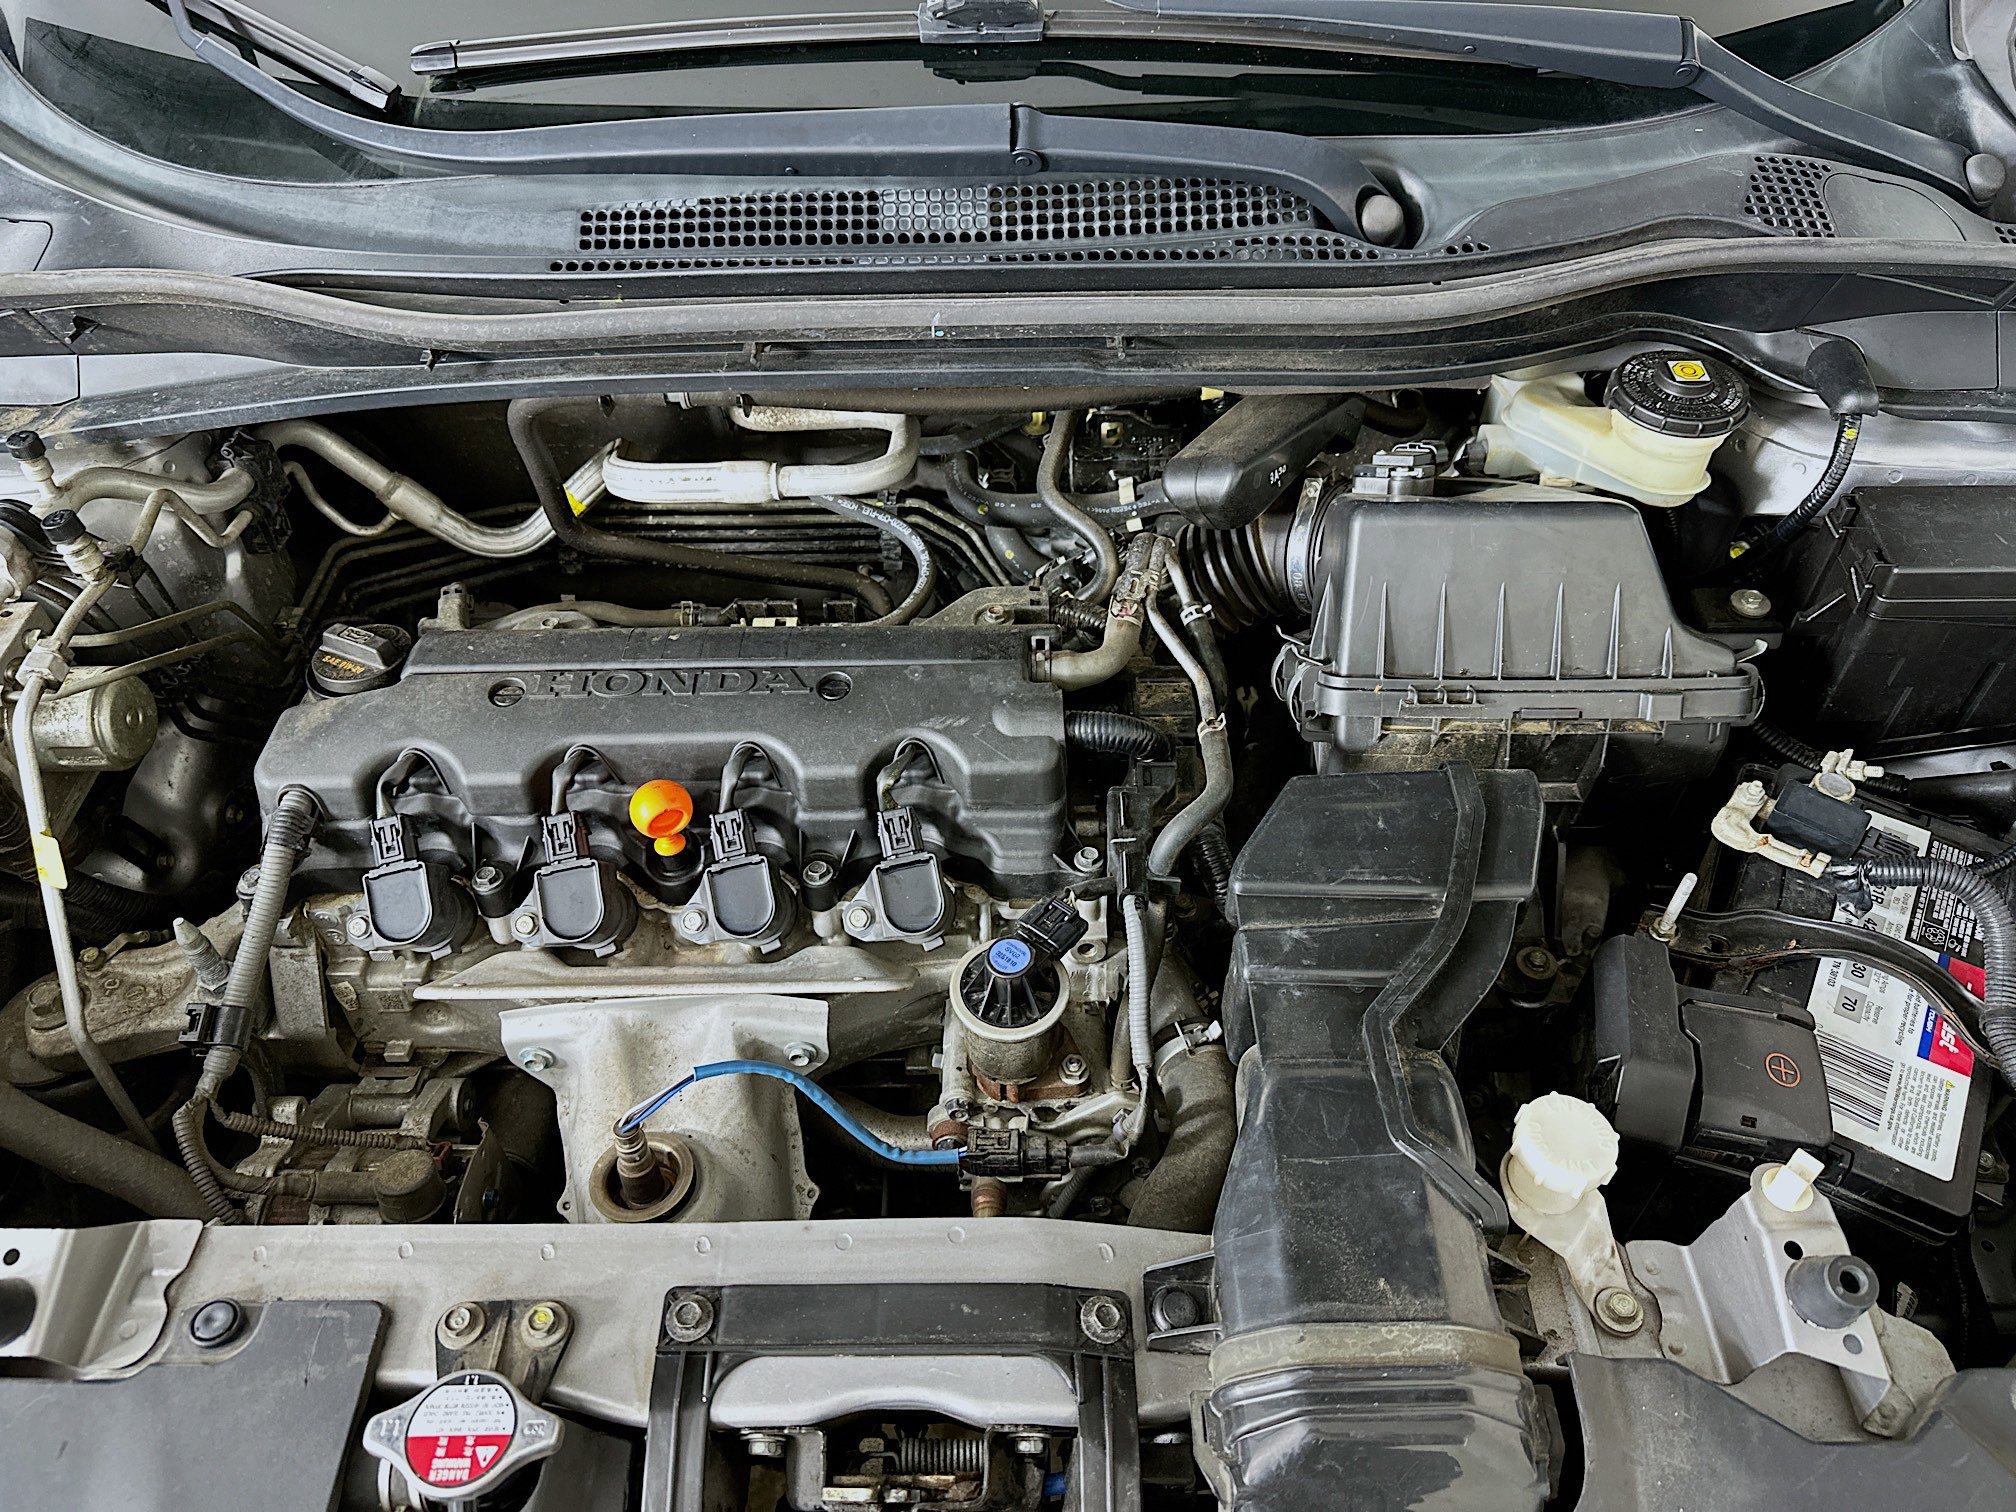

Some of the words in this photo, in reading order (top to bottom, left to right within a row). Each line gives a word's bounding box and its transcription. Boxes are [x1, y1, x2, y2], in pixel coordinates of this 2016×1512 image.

[322, 655, 341, 665] SAE
[529, 668, 814, 698] HONDA
[1827, 968, 1839, 988] 38103
[1841, 995, 1858, 1013] 70
[1861, 1000, 1875, 1023] Capacity
[1871, 1005, 1883, 1025] Reserve
[1909, 1002, 1921, 1028] batteries
[1926, 1008, 1936, 1033] TOUGH
[1895, 1020, 1908, 1047] recycling
[431, 1457, 471, 1469] WARNING
[428, 1469, 470, 1481] DANGER
